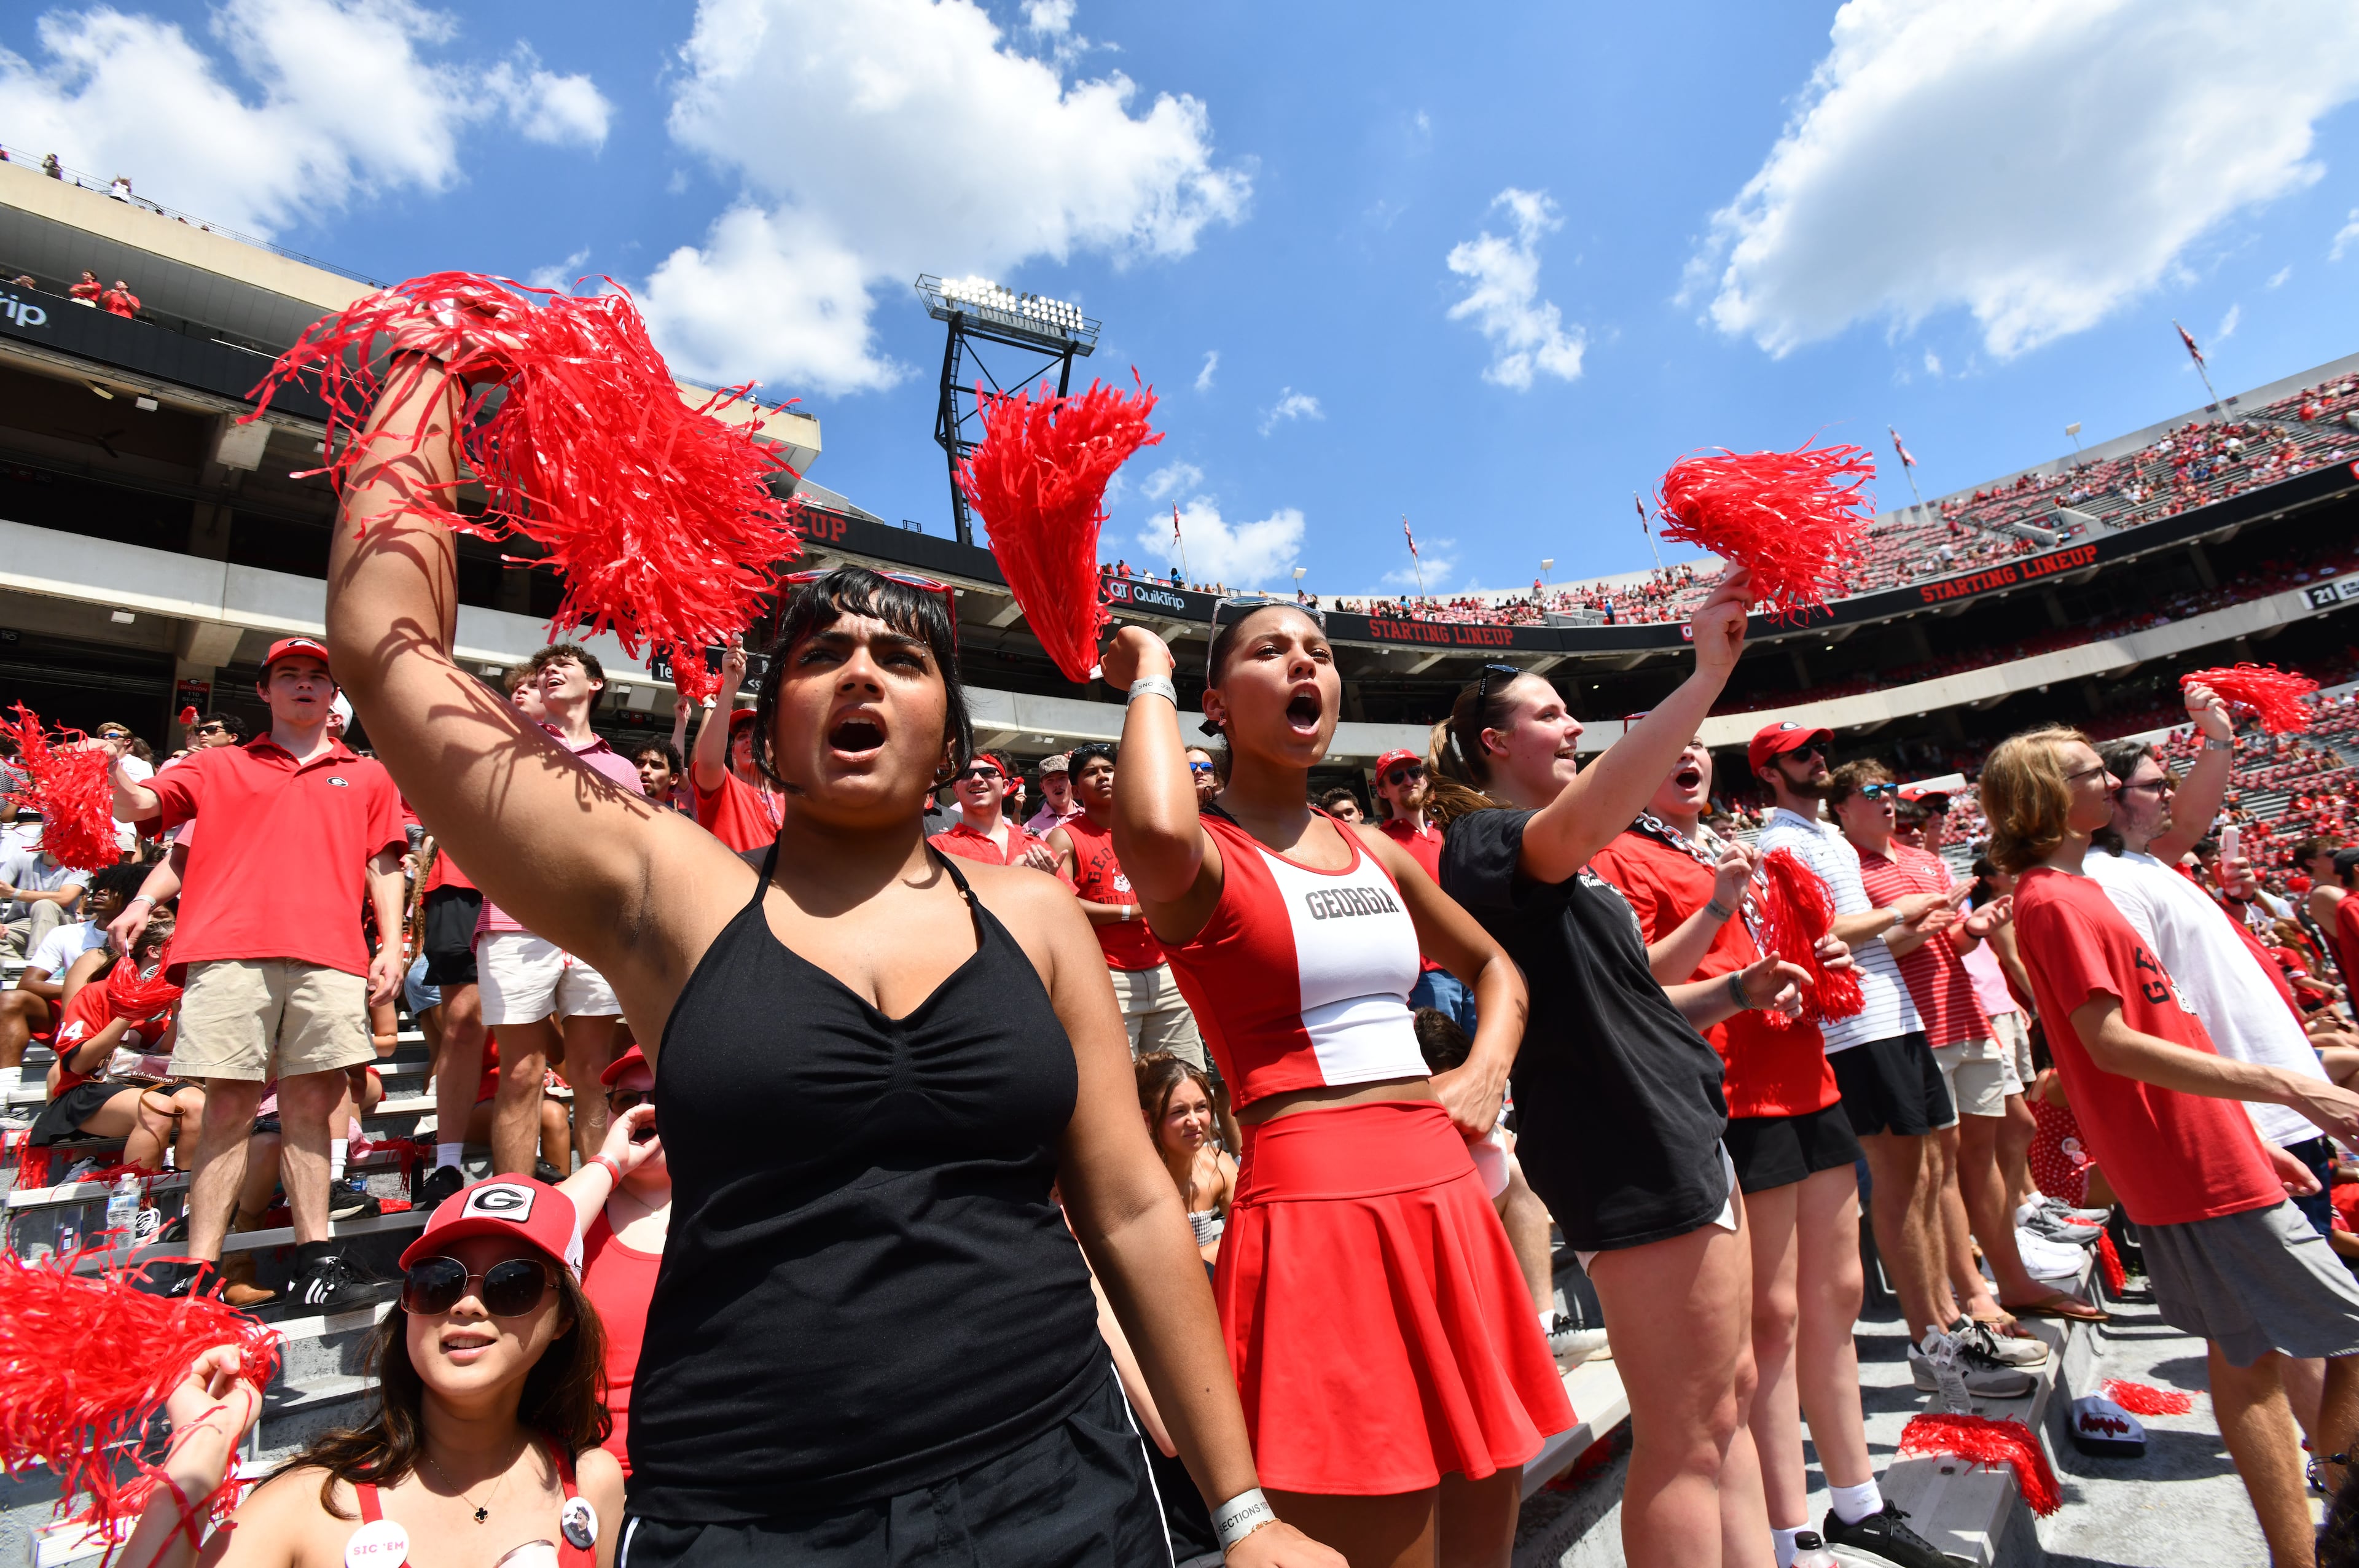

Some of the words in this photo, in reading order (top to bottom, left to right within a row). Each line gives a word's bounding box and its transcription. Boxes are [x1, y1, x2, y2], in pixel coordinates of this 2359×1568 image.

[1920, 566, 2017, 603] STARTING
[2020, 545, 2097, 579] LINEUP
[1109, 582, 1128, 598] QT
[1133, 585, 1185, 610] QuikTrip
[2313, 587, 2336, 604] 21
[1369, 619, 1450, 644] STARTING
[1453, 626, 1514, 646] LINEUP
[1138, 682, 1172, 693] SECONS
[1305, 887, 1400, 920] GEORGIA
[131, 1071, 173, 1083] lululemon
[1218, 1504, 1261, 1535] SECTIONS
[353, 1544, 378, 1556] SIC
[383, 1540, 404, 1551] 'EM
